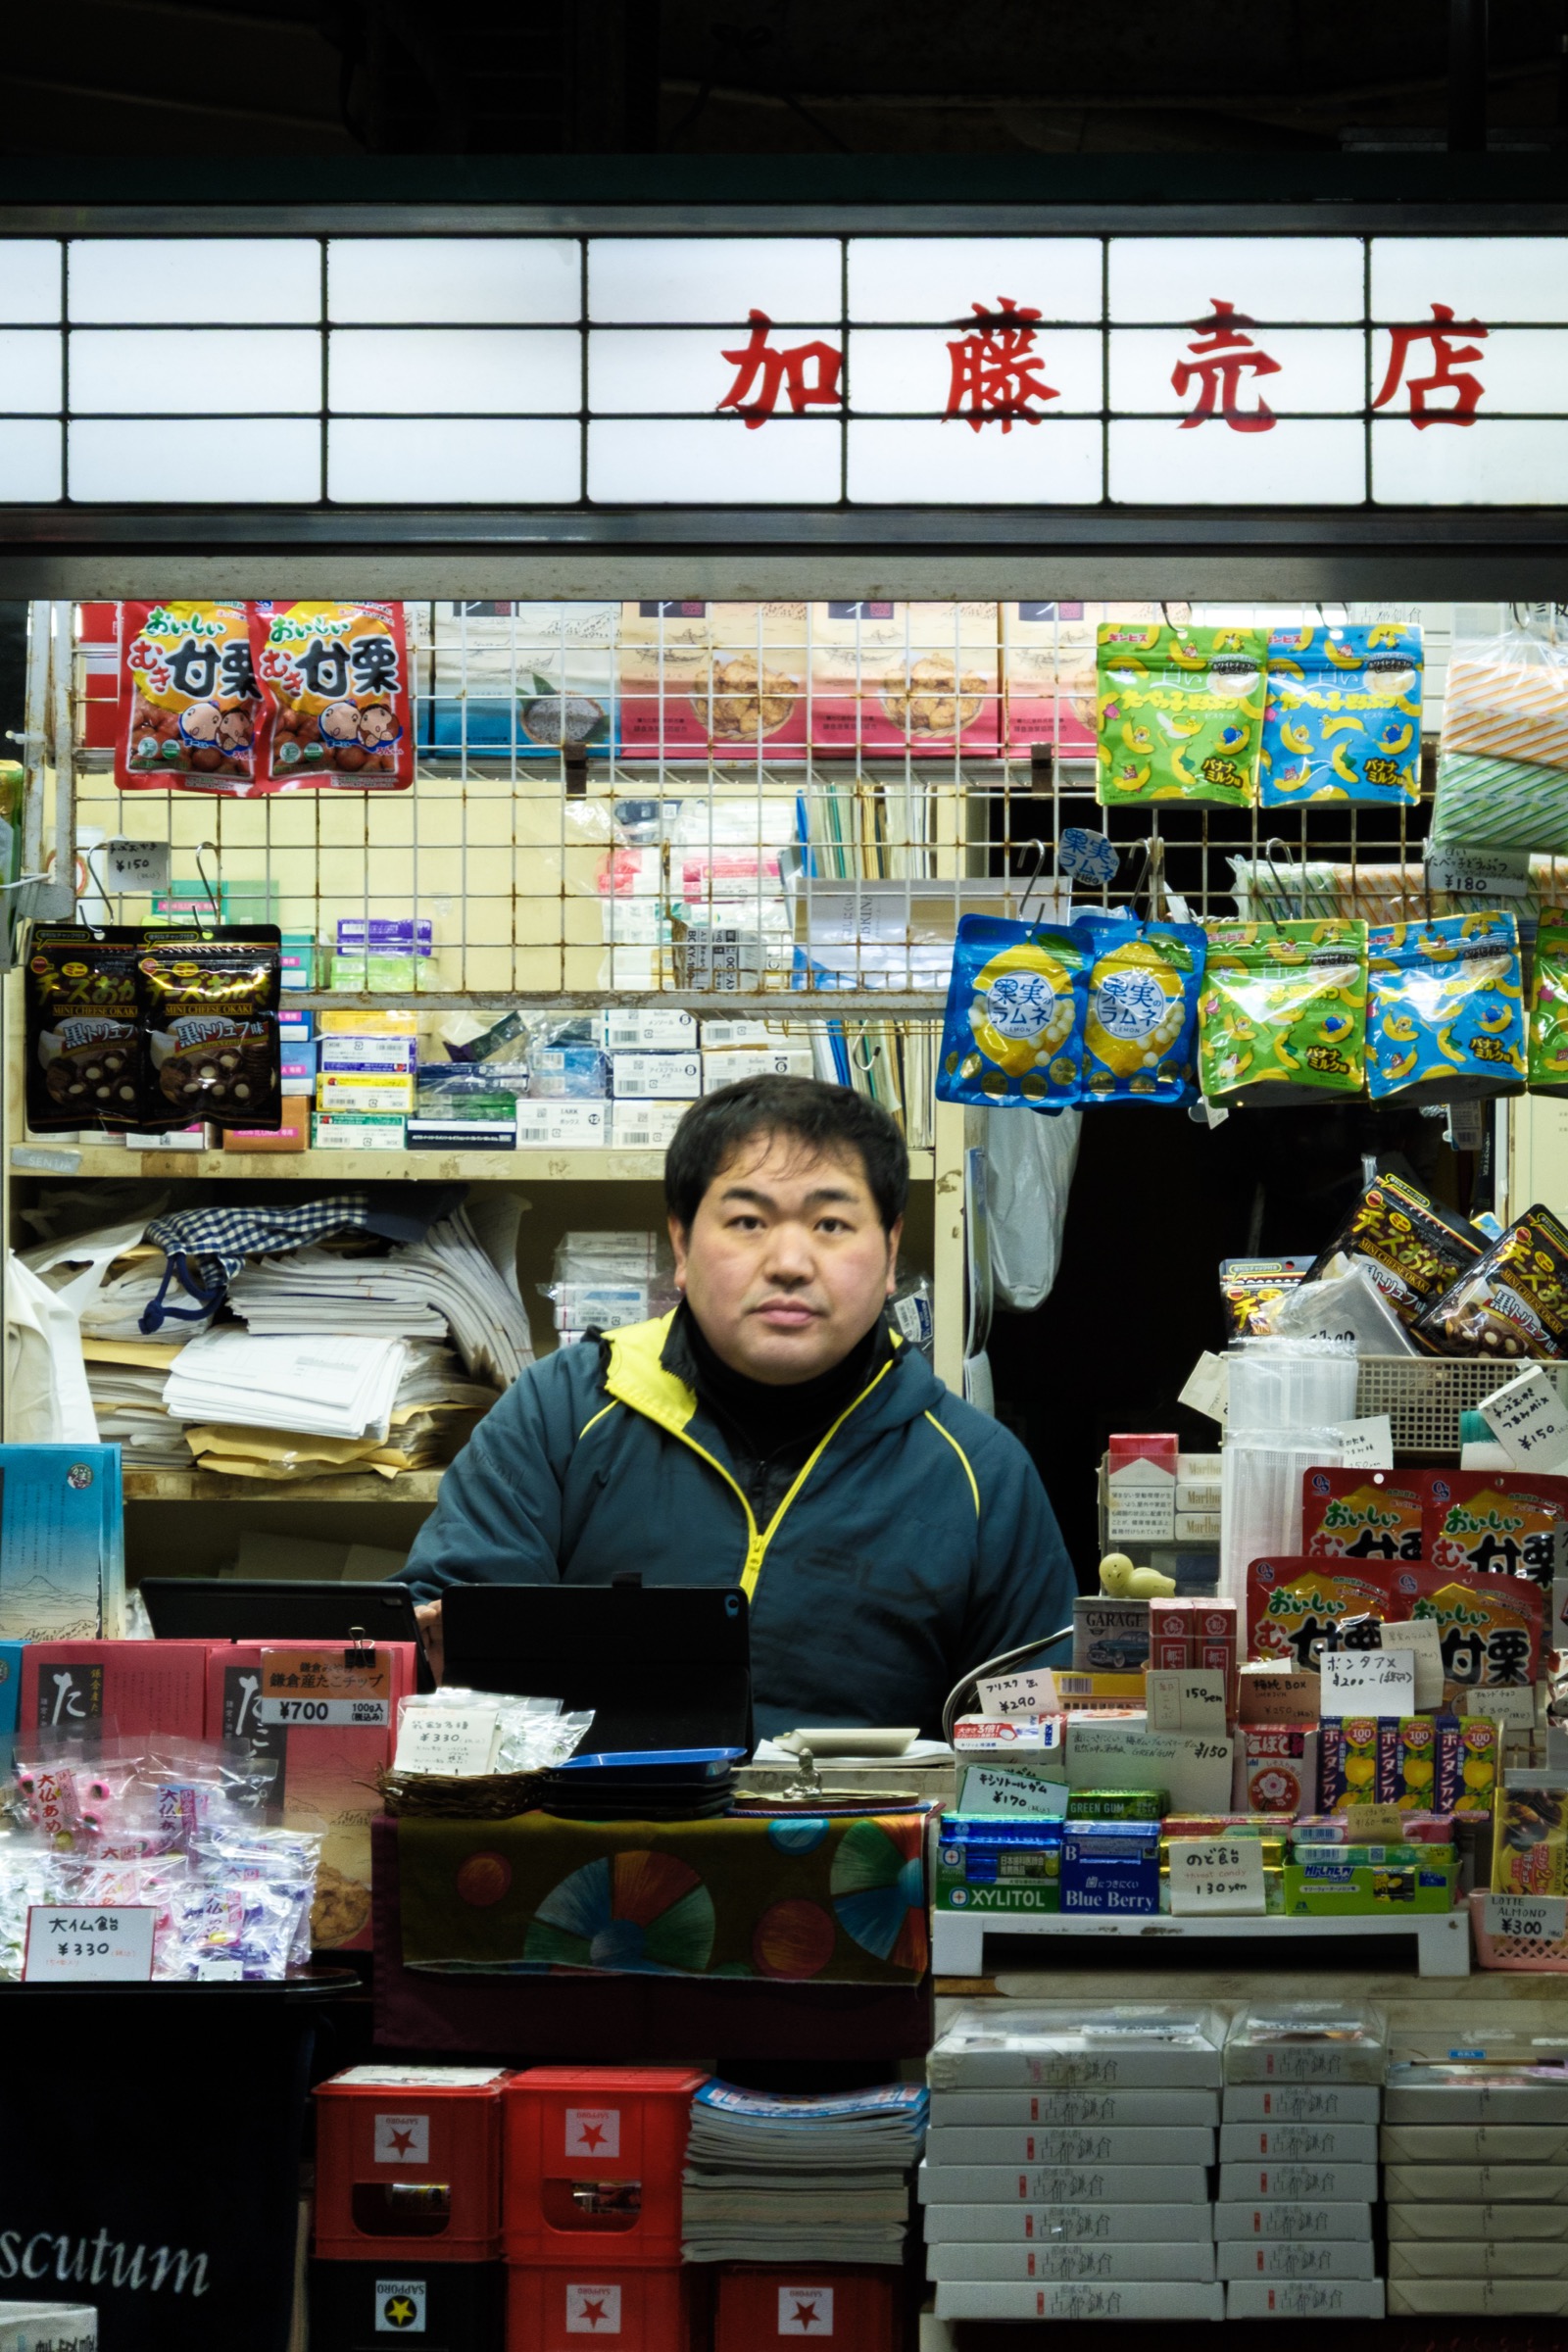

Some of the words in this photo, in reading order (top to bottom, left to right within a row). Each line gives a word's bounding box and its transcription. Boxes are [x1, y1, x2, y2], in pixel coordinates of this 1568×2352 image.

[716, 296, 1489, 434] 加藤売店
[146, 607, 226, 637] おいしい
[270, 615, 351, 643] おいしい
[166, 639, 263, 698] 甘栗
[295, 635, 401, 697] 甘栗
[1162, 663, 1202, 686] 白い
[1318, 663, 1359, 686] 白い
[1203, 758, 1237, 773] バナナ
[1364, 759, 1398, 773] バナナ
[116, 858, 150, 872] ¥150
[1445, 873, 1488, 891] ¥180
[993, 976, 1052, 1006] 果実の
[1102, 975, 1162, 1008] 果実の
[166, 1004, 185, 1015] MINI
[187, 1004, 221, 1015] CHEESE
[991, 1006, 1051, 1026] ラムネ
[1101, 1006, 1160, 1027] ラムネ
[177, 1020, 265, 1049] 黒トリュフ味
[1470, 1035, 1503, 1053] バナナ
[1306, 1046, 1340, 1063] バナナ
[1380, 1253, 1405, 1279] CHEESE
[1490, 1291, 1559, 1353] 黒トリュフ味
[1518, 1425, 1555, 1451] ¥150
[1325, 1497, 1400, 1528] おいしい
[1446, 1504, 1524, 1535] おいしい
[1268, 1587, 1347, 1616] おいしい
[1086, 1612, 1143, 1628] GARAGE
[1413, 1598, 1491, 1627] おいしい
[1441, 1629, 1531, 1685] 甘栗
[270, 1673, 384, 1689] 鎌倉産たこチップ
[986, 1679, 1018, 1693] フリスク
[1285, 1681, 1307, 1690] BOX
[1186, 1688, 1207, 1699] 150
[279, 1701, 329, 1720] ¥700
[352, 1703, 384, 1712] 100g入
[999, 1696, 1037, 1713] ¥290
[419, 1733, 461, 1742] ¥330
[1044, 1723, 1054, 1746] FRISK
[1351, 1729, 1372, 1738] 100
[1409, 1731, 1430, 1740] 100
[1470, 1733, 1491, 1742] 100
[1194, 1741, 1229, 1759] ¥150
[992, 1790, 1027, 1807] ¥170
[1070, 1801, 1101, 1813] GREEN
[1103, 1801, 1125, 1813] GUM
[1186, 1847, 1240, 1867] のど飴
[971, 1889, 1046, 1907] XYLITOL
[1196, 1883, 1226, 1895] 130
[1228, 1883, 1248, 1893] yen
[1066, 1890, 1102, 1908] Blue
[1107, 1891, 1155, 1912] Berry
[1491, 1896, 1525, 1906] LOTTE
[1497, 1906, 1547, 1918] ALMOND
[48, 1915, 120, 1934] 大仏飴
[1500, 1917, 1543, 1936] ¥300
[57, 1942, 110, 1957] ¥330
[377, 2283, 425, 2295] SAPPORO
[789, 2289, 822, 2298] SAPPORO
